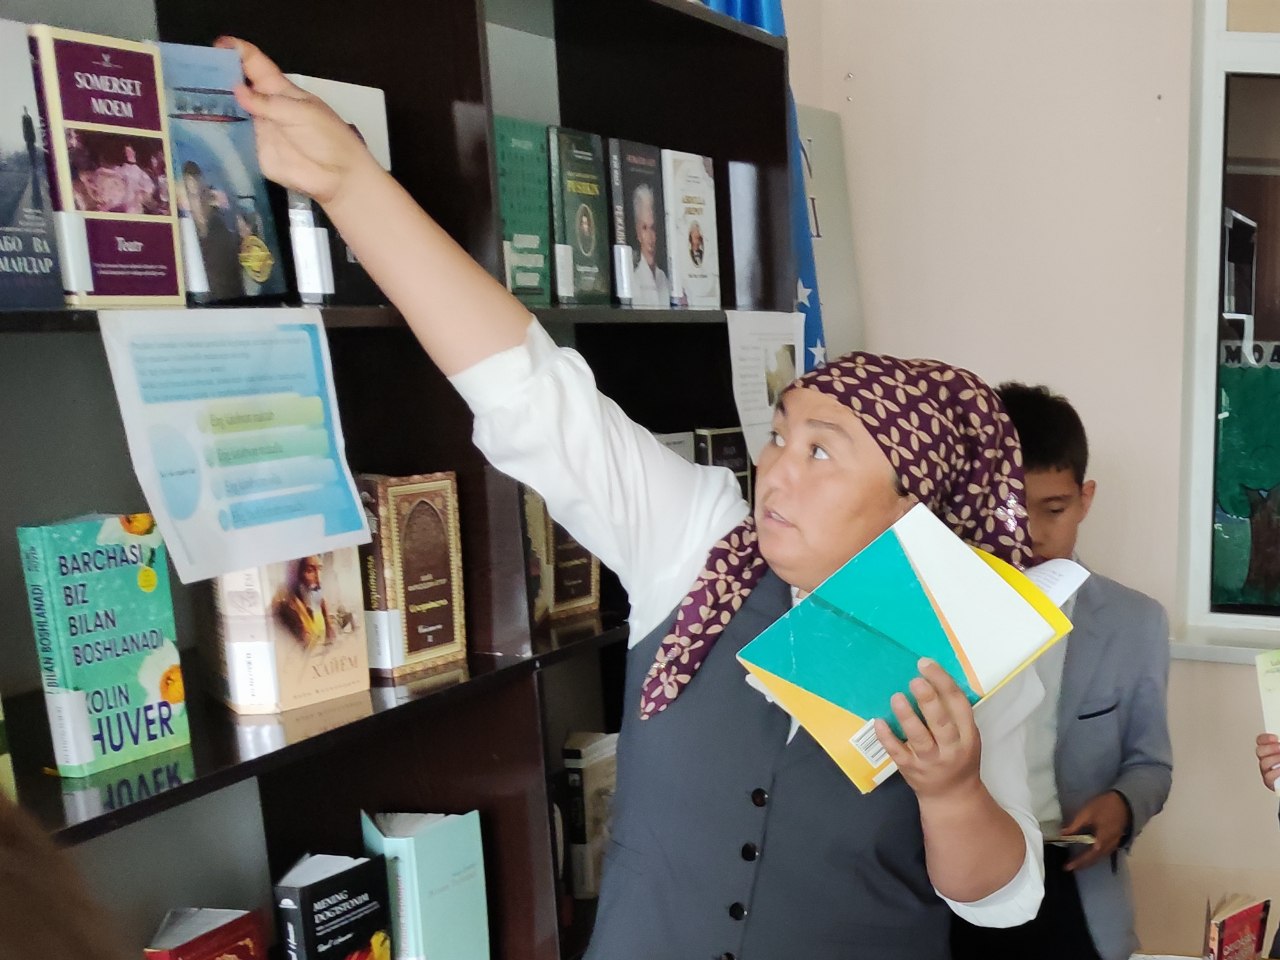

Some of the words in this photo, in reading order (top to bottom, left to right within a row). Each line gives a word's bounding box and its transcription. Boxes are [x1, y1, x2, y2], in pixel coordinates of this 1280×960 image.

[74, 71, 142, 96] SOMERSET
[91, 97, 133, 118] MOEM
[58, 544, 143, 576] BARCHASI
[64, 583, 88, 606] BIZ
[31, 585, 51, 653] BOSHLANADI
[68, 609, 117, 636] BILAN
[73, 629, 164, 667] BOSHLANADI
